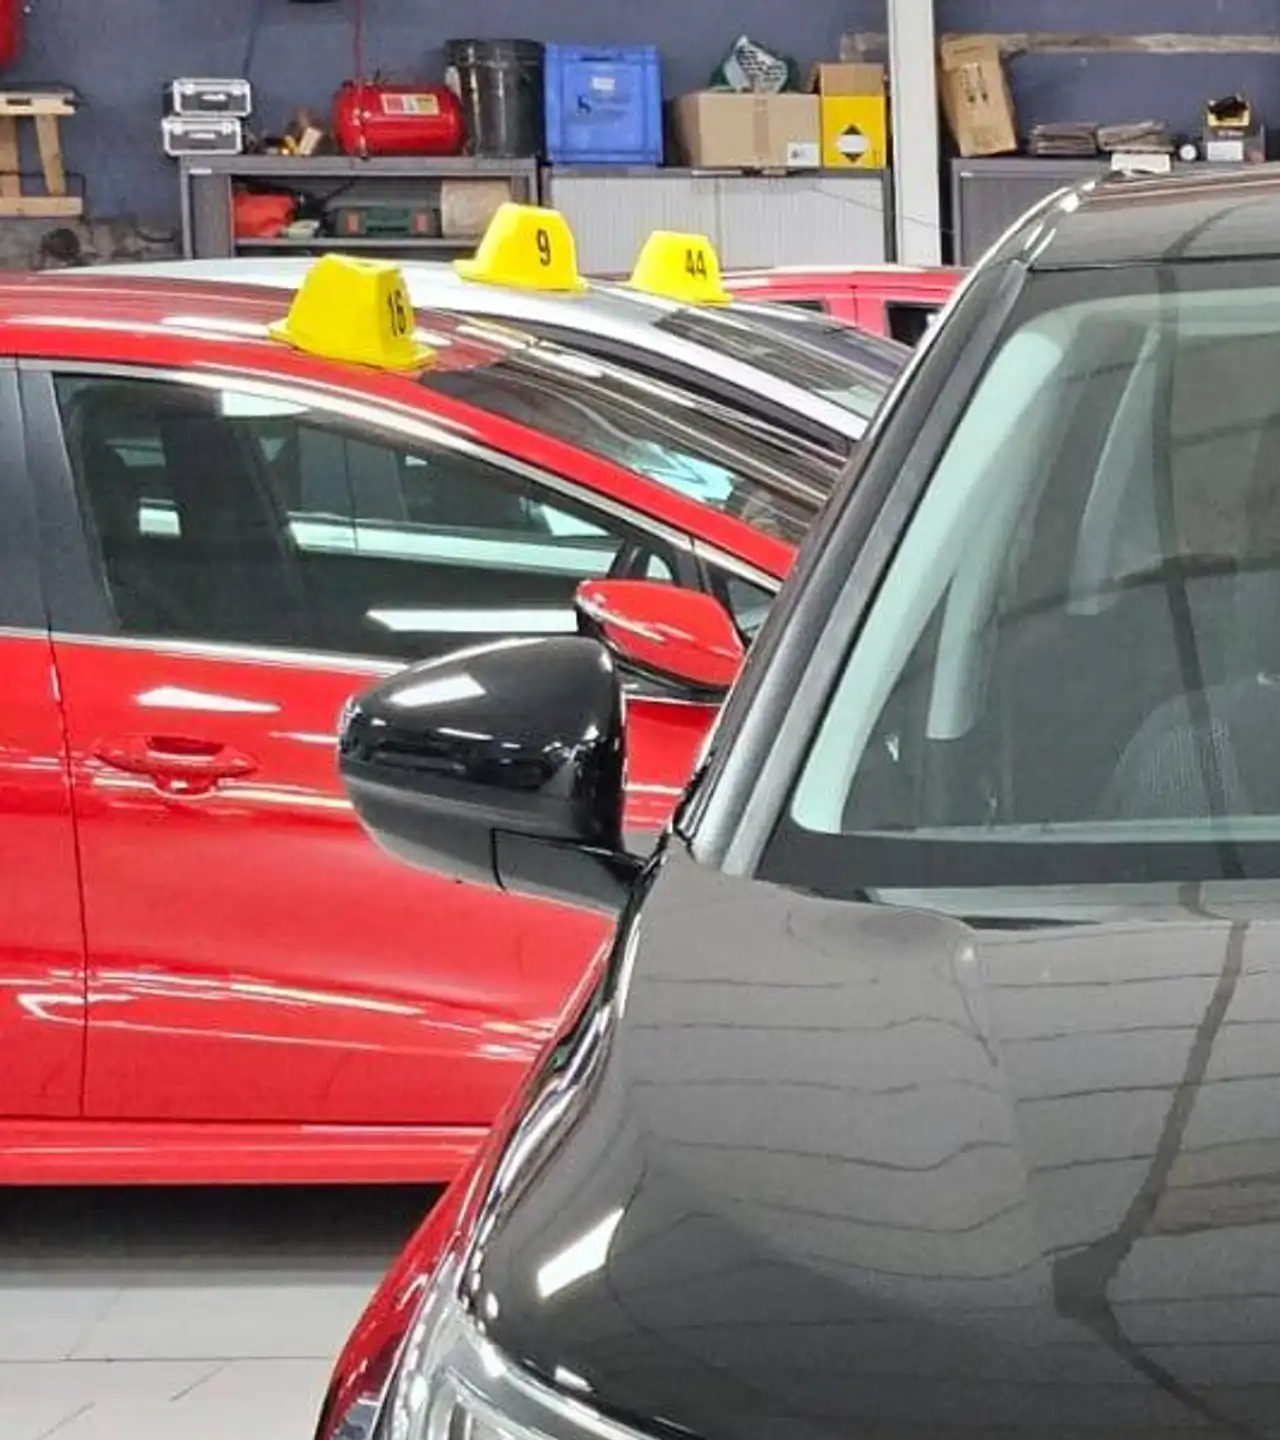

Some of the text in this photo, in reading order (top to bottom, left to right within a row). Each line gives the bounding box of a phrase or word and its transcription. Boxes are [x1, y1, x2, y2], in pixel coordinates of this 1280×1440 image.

[535, 227, 552, 268] 9
[684, 248, 708, 282] 44
[386, 288, 408, 338] 16
